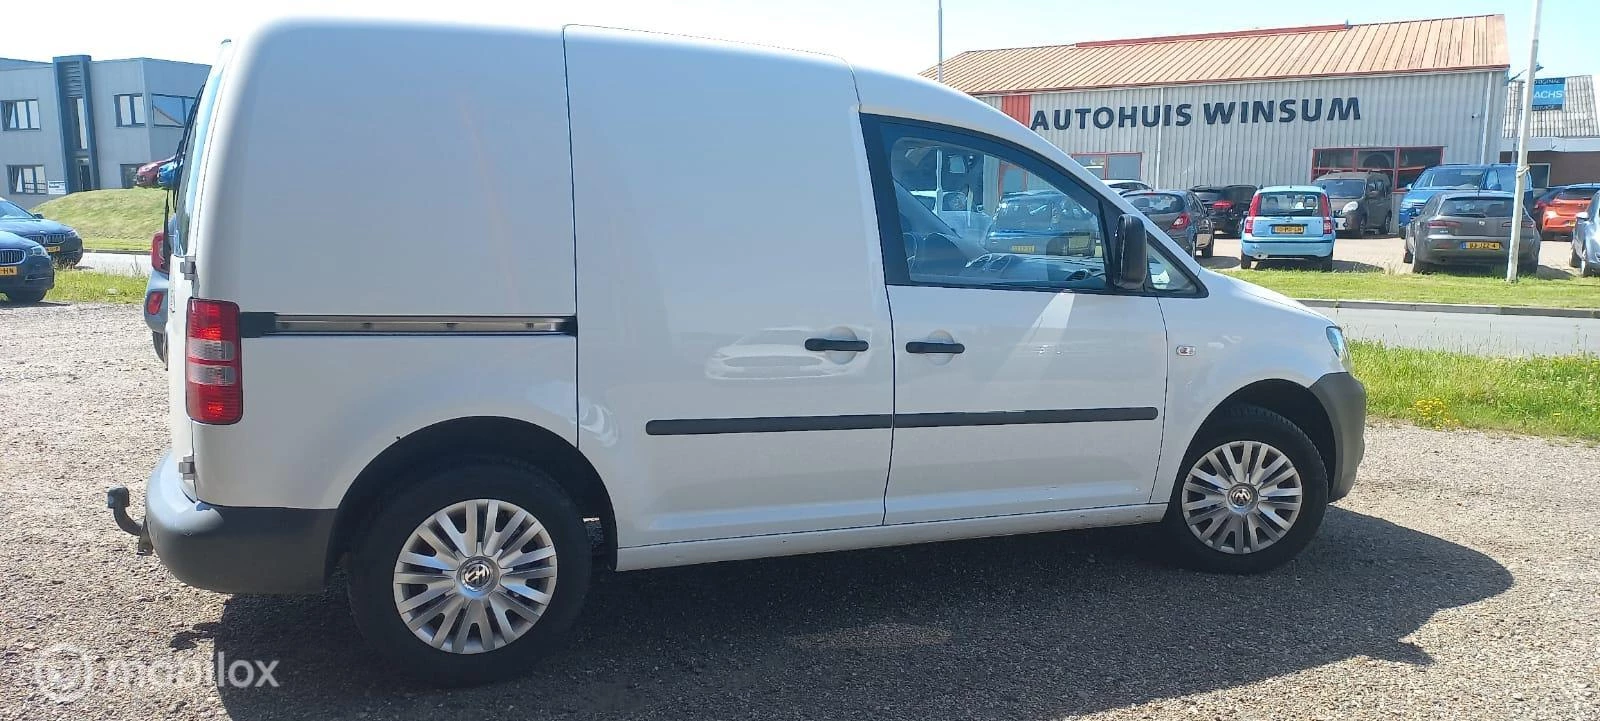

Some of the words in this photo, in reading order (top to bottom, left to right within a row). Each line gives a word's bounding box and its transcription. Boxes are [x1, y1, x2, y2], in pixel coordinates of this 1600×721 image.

[1534, 90, 1563, 99] ACHS
[1031, 103, 1192, 131] AUTOHUIS
[1203, 96, 1362, 125] WINSUM
